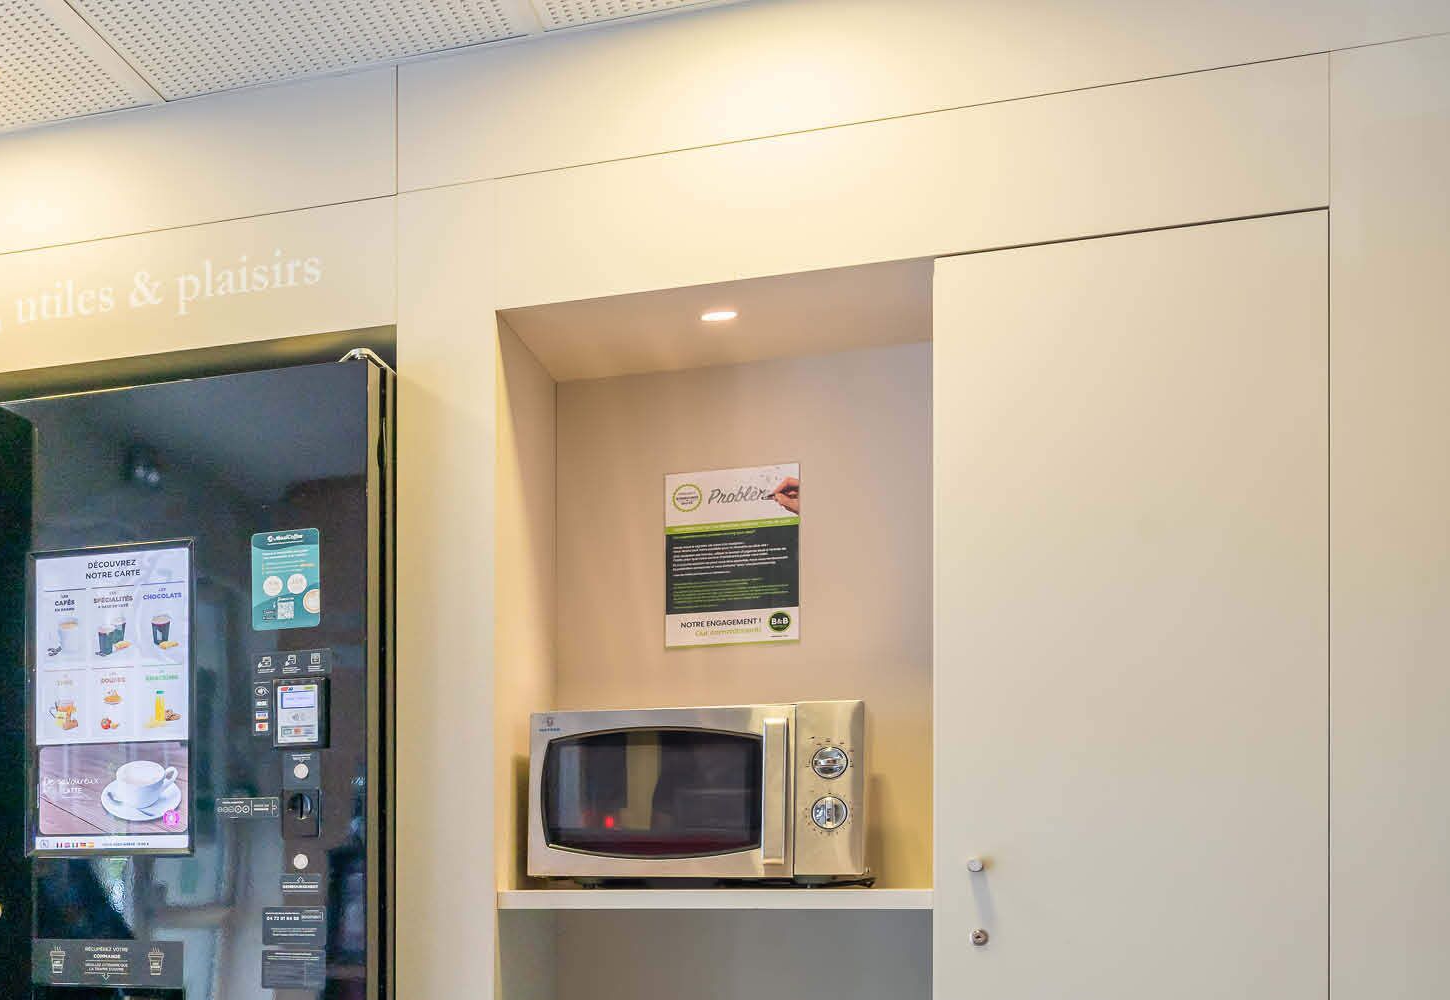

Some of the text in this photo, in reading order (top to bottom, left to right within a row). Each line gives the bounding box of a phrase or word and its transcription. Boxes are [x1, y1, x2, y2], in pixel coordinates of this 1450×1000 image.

[15, 283, 116, 326] utiles
[128, 270, 165, 308] &
[175, 248, 324, 316] plaisirs
[88, 559, 136, 569] DÉCOUVREZ
[86, 569, 140, 579] NOTRE CARTE
[142, 592, 182, 600] CHOCOLATS
[54, 599, 75, 611] CAFÉS
[680, 620, 705, 629] NOTRE
[706, 617, 757, 628] ENGAGEMENT
